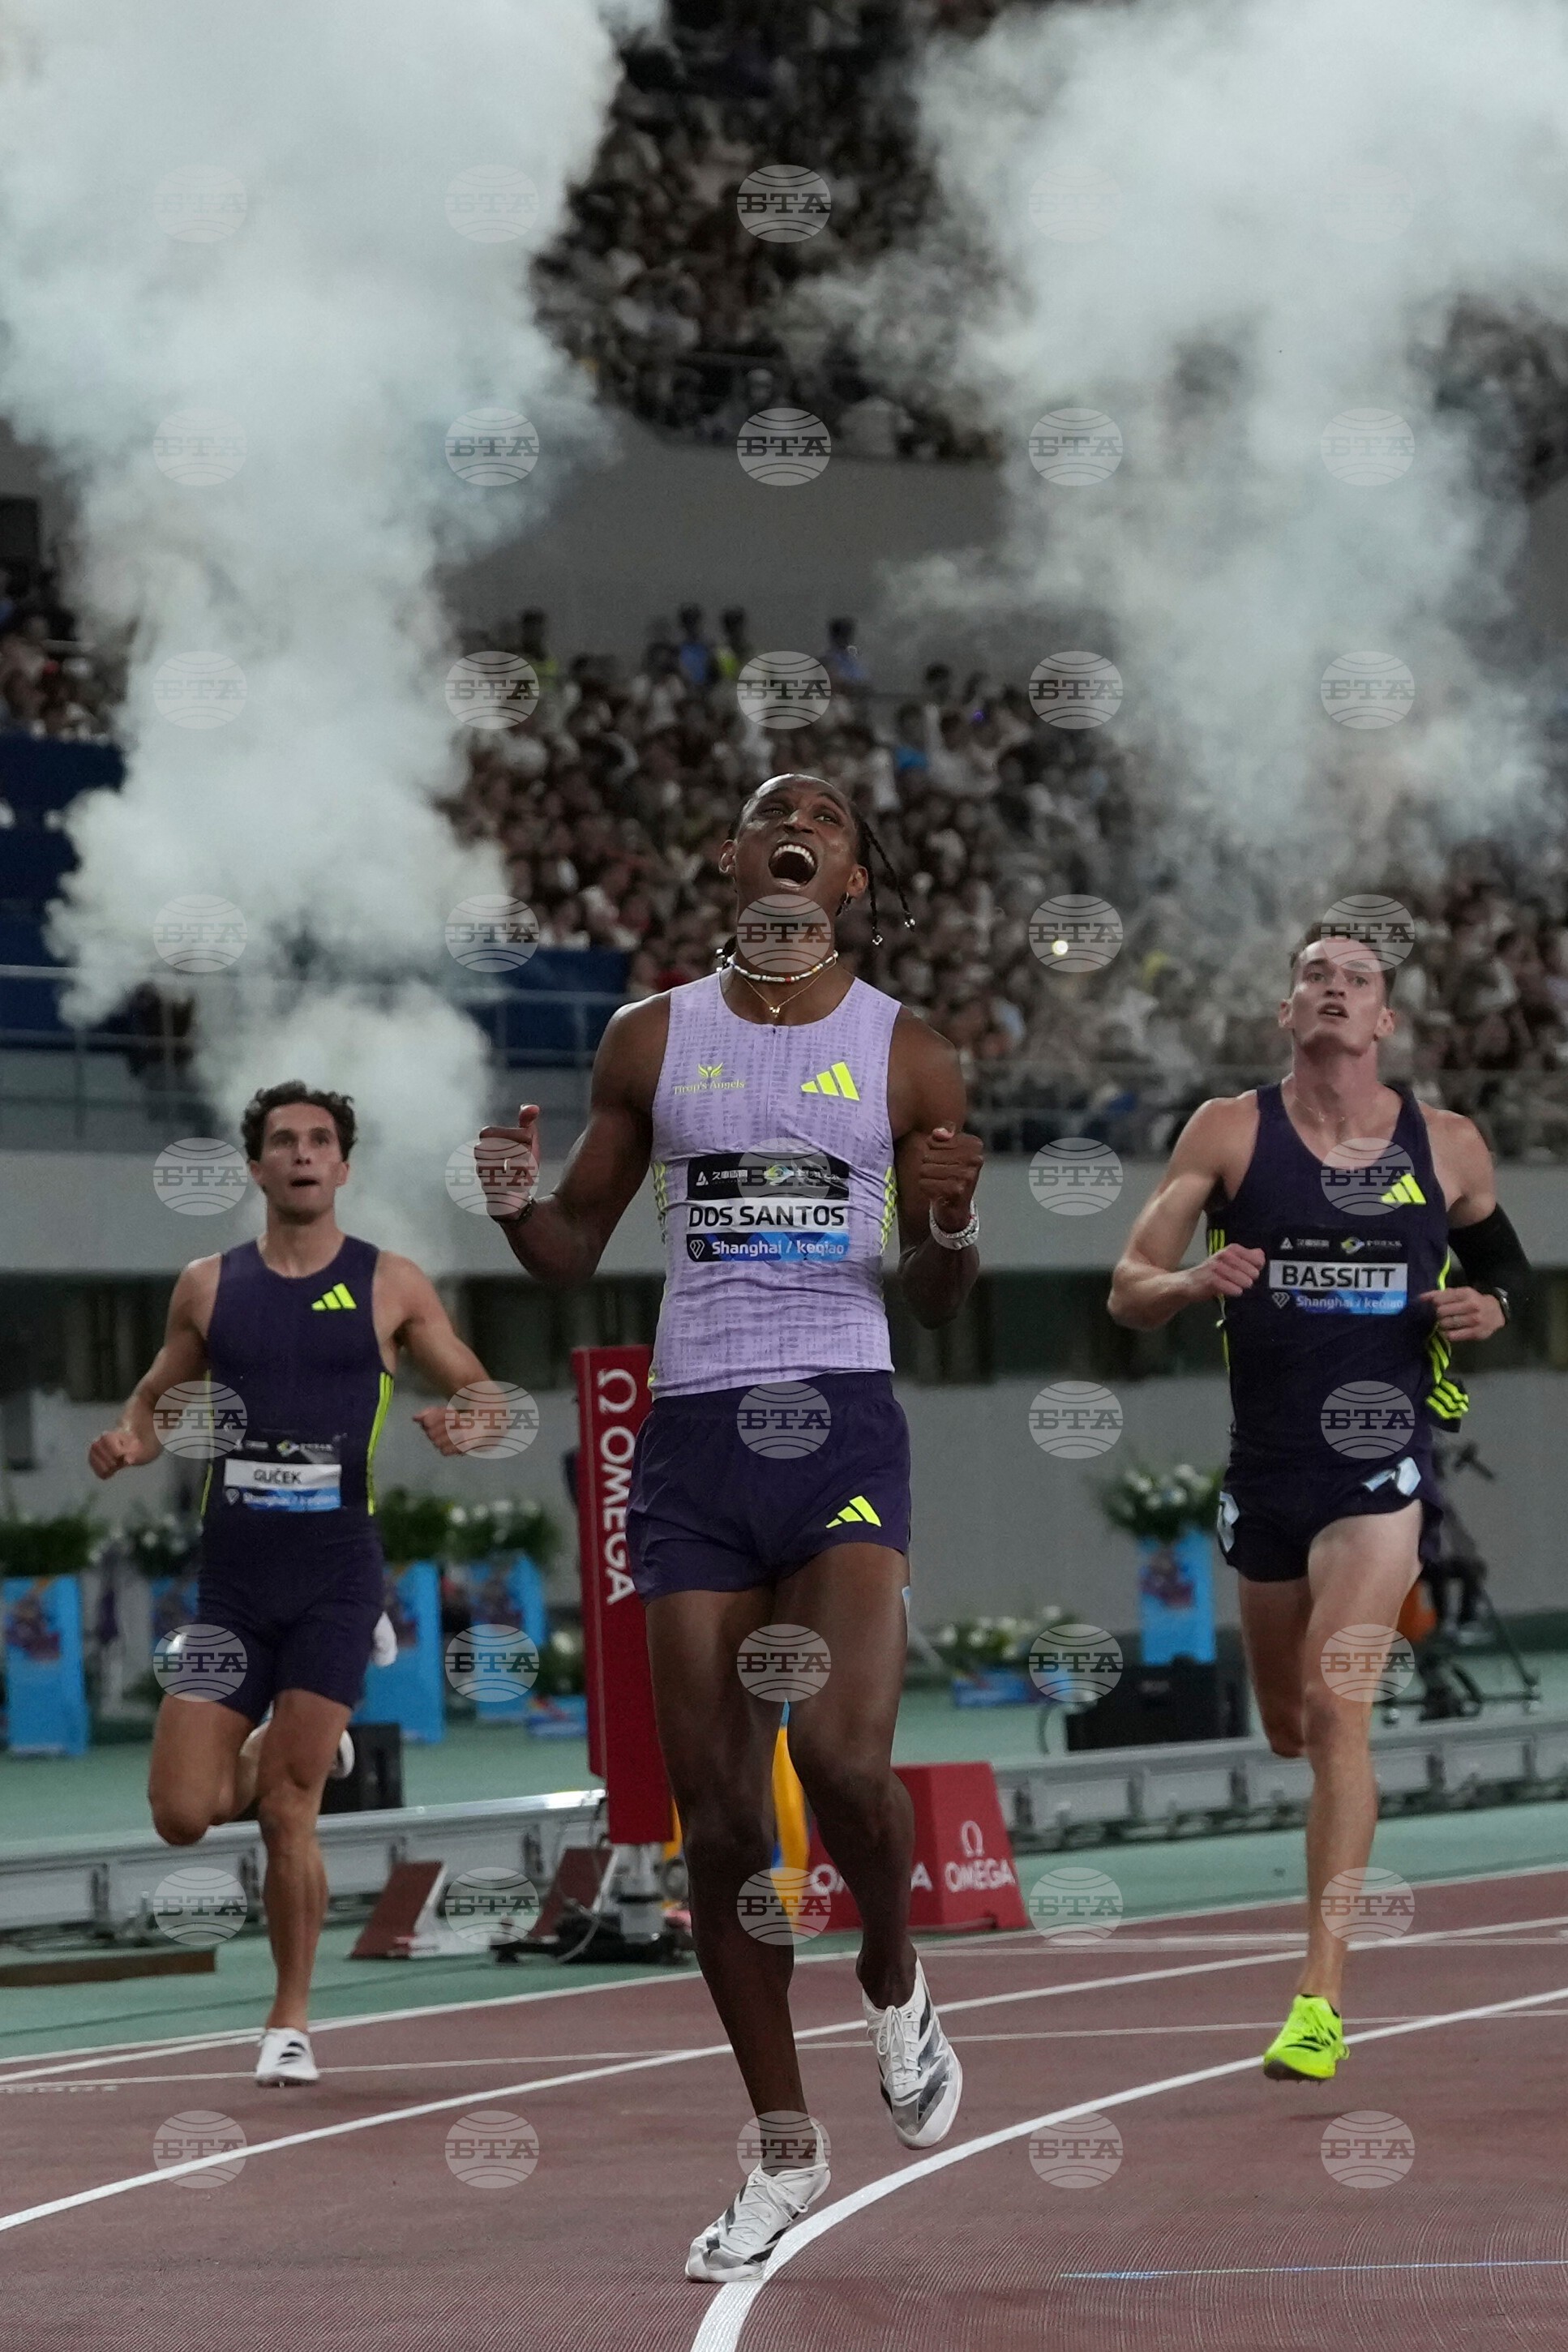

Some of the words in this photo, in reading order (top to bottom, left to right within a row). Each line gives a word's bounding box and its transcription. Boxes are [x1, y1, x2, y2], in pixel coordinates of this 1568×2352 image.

[710, 1079, 745, 1090] Angels
[689, 1206, 733, 1227] DOS
[739, 1205, 845, 1227] SANTOS
[712, 1241, 782, 1255] Shanghai
[1282, 1264, 1396, 1288] BASSITT
[254, 1467, 302, 1484] GUČEK
[600, 1425, 636, 1605] OMEGA
[945, 1857, 1016, 1893] OMEGA
